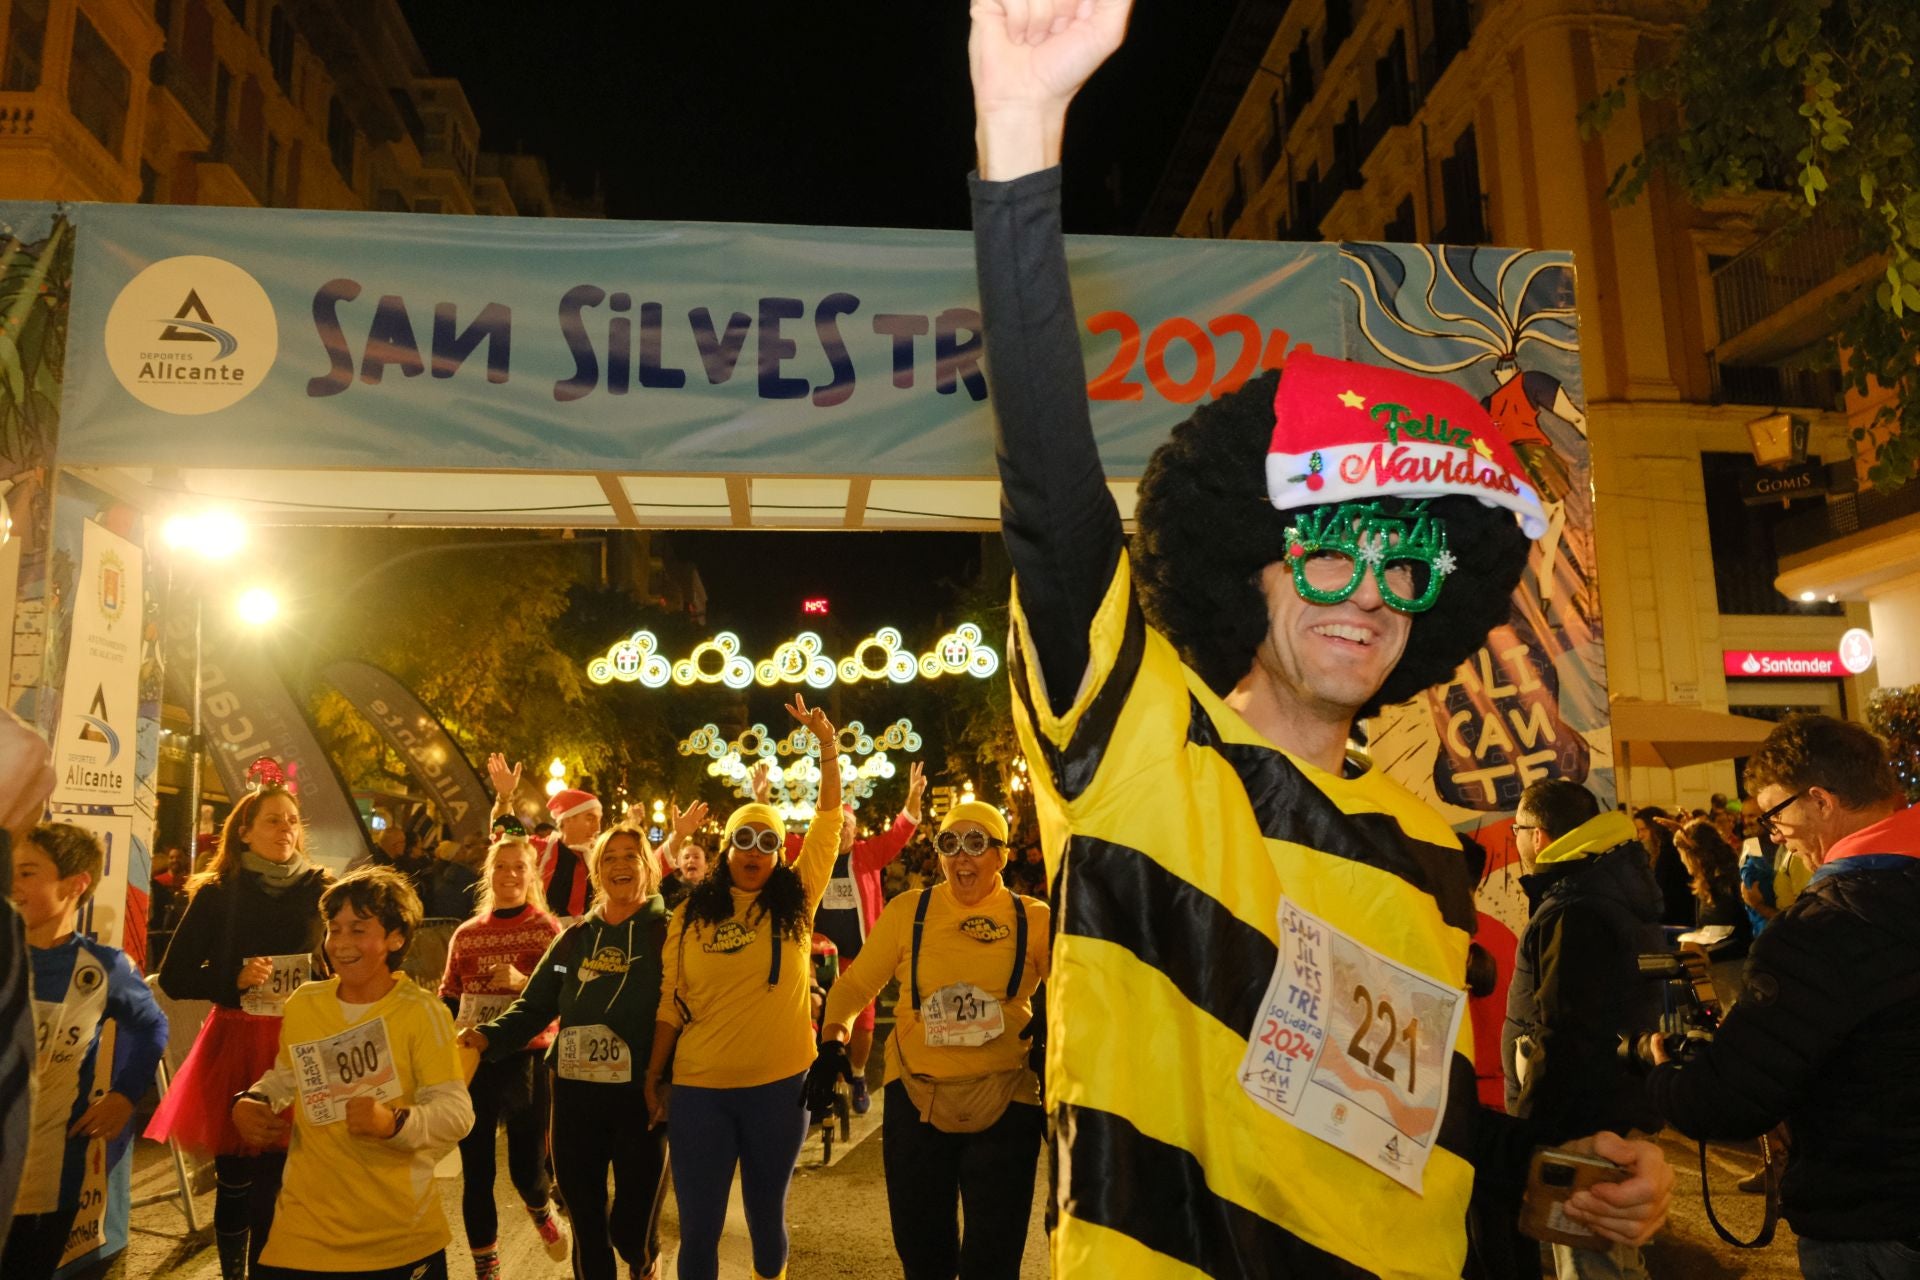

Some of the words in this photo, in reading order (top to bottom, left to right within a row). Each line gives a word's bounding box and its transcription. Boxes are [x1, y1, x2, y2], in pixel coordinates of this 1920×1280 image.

[306, 278, 511, 398] SAN
[553, 284, 989, 407] SiLVESTR
[139, 352, 193, 361] DEPORTES
[138, 361, 245, 381] Alicante
[1370, 403, 1475, 446] Feliz
[1340, 443, 1520, 496] Navidad
[1761, 656, 1832, 673] Santander
[1447, 702, 1556, 759] CAN
[65, 764, 122, 789] Alicante
[703, 930, 757, 952] MINIONS
[1289, 911, 1320, 946] SAN
[582, 957, 629, 973] MINIONS
[1294, 961, 1322, 994] VES
[273, 968, 301, 993] 516
[1289, 984, 1321, 1020] TRE
[589, 1037, 619, 1062] 236
[1260, 1019, 1314, 1062] 2024
[1347, 985, 1419, 1094] 221
[336, 1040, 378, 1084] 800
[1264, 1050, 1293, 1072] ALI
[1260, 1068, 1290, 1089] CAN
[1260, 1085, 1287, 1103] TE
